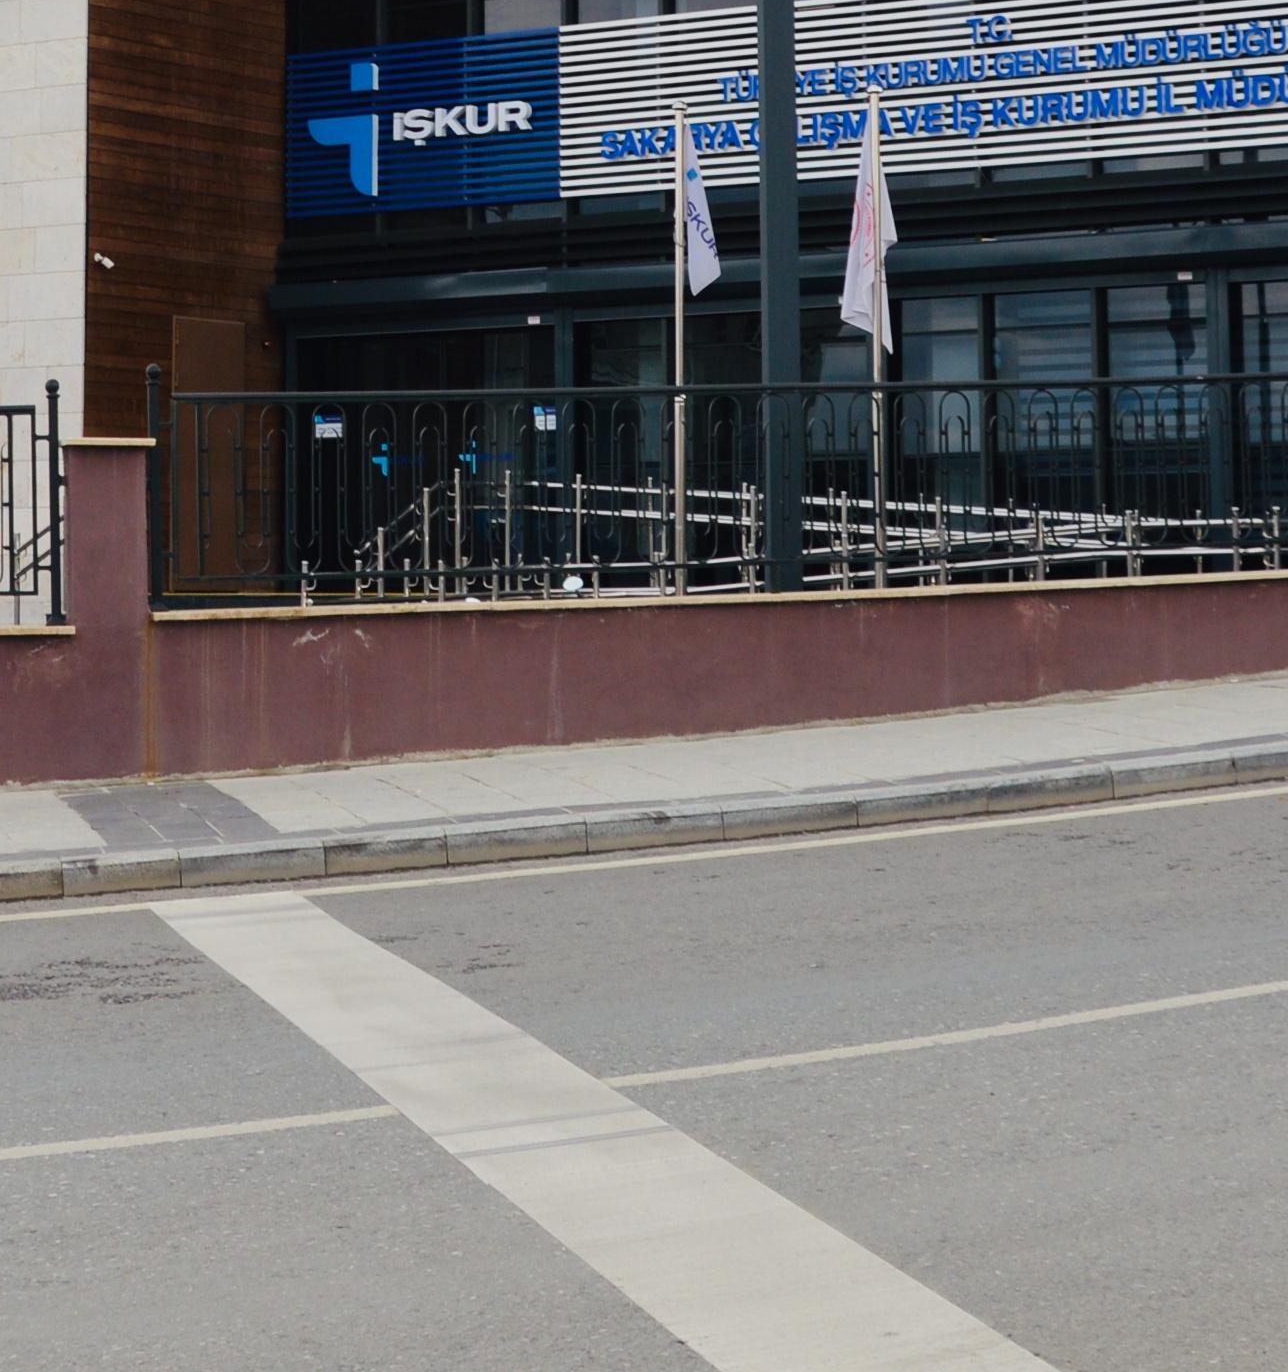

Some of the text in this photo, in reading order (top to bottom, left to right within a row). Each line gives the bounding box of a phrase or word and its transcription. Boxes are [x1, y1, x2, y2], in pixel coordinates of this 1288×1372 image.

[716, 68, 831, 103] TÜYE
[834, 60, 860, 99] İŞ
[863, 53, 989, 90] KURUMU
[992, 44, 1090, 79] GENEL
[392, 100, 533, 146] İŞKUR
[901, 102, 947, 136] VE
[953, 93, 985, 139] İŞ
[991, 85, 1147, 129] KURUMU
[1156, 77, 1186, 114] İL
